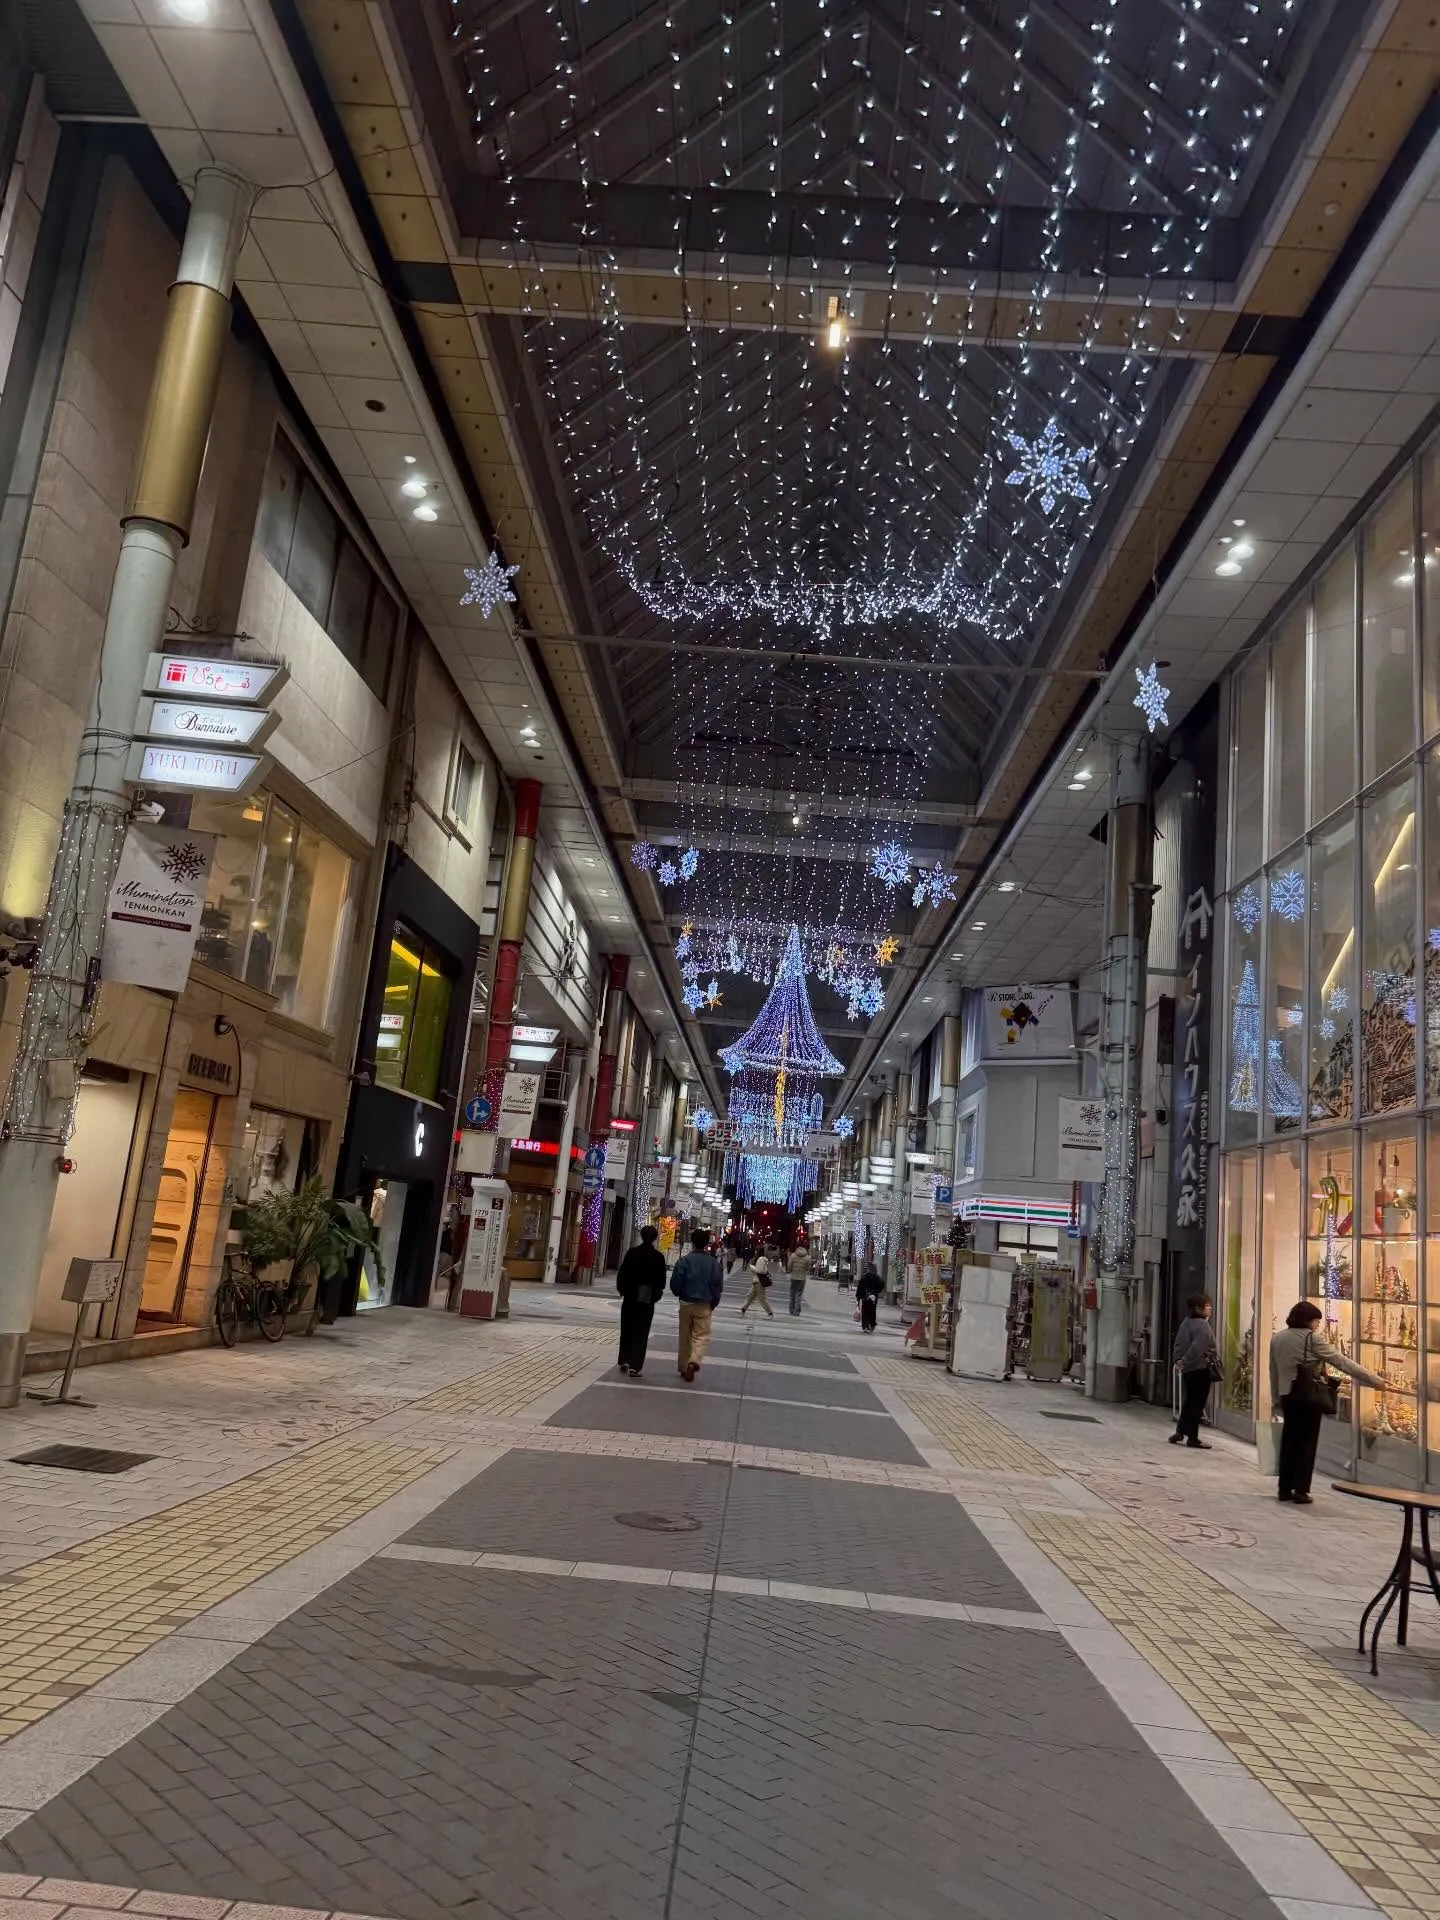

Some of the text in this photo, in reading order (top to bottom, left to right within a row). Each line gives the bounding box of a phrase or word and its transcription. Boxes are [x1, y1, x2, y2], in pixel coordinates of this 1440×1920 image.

[148, 752, 238, 775] YUKI TORII
[124, 901, 186, 918] TENMONKAN
[940, 1188, 950, 1200] P
